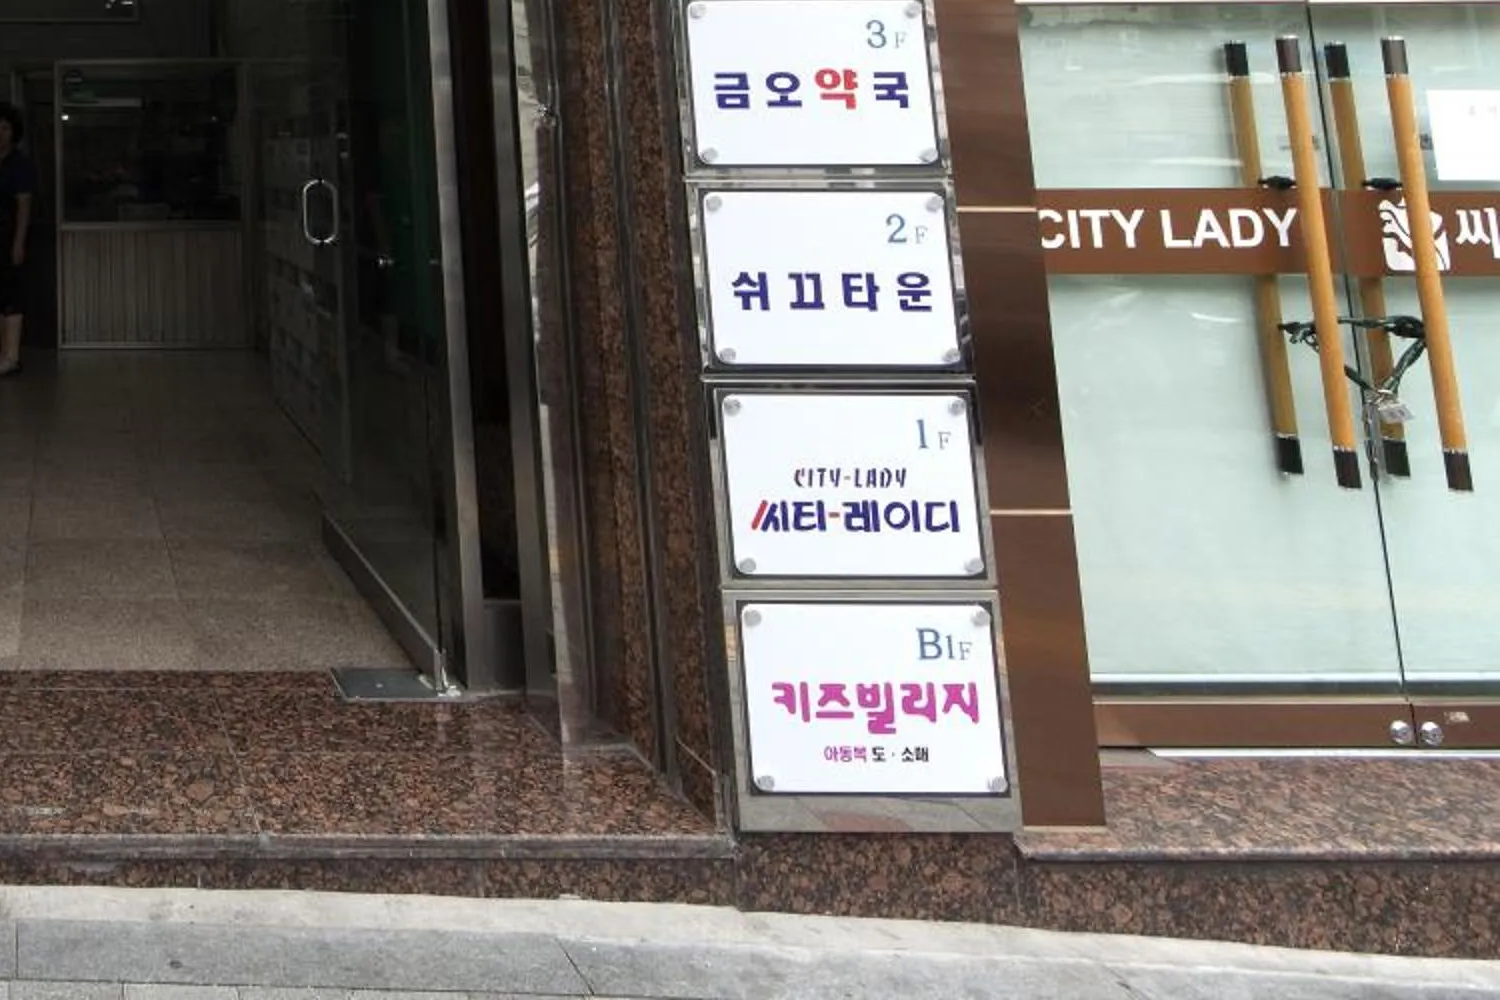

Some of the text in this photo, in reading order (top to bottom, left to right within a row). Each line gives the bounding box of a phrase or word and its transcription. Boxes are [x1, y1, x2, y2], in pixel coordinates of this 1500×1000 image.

[866, 19, 907, 49] 3F
[713, 68, 910, 110] 금오약국
[885, 213, 928, 244] 2F
[1040, 209, 1297, 249] CITY LADY
[916, 418, 951, 450] 1F
[771, 681, 981, 735] 키즈빌리지
